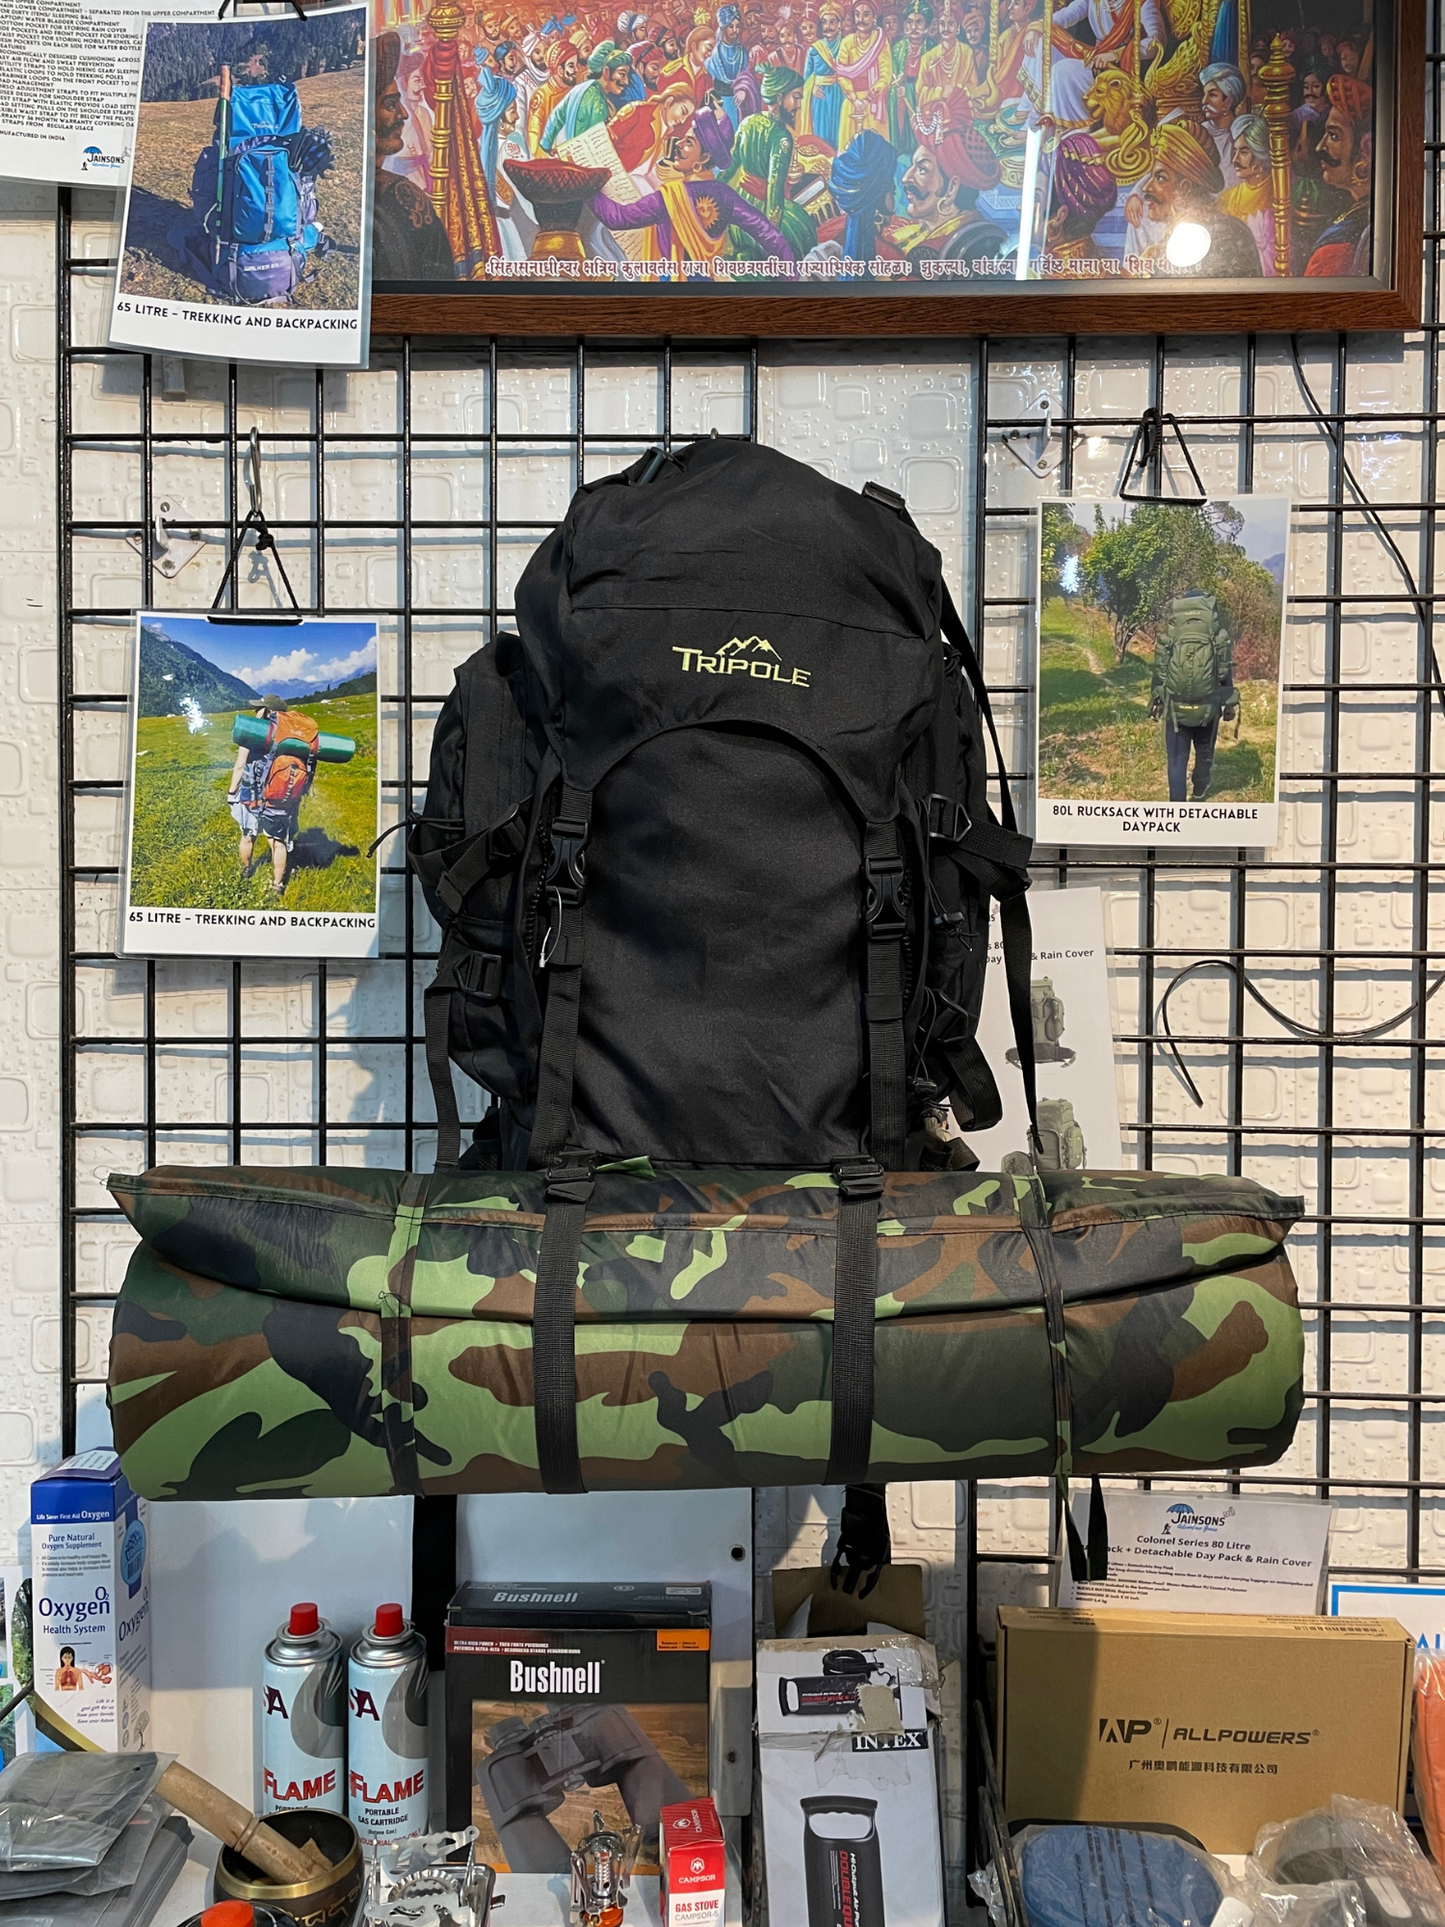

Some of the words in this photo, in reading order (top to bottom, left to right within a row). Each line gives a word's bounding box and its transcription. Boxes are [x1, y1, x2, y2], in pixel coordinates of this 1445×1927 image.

[87, 154, 124, 164] JAINSONS
[682, 258, 708, 276] राजा
[1069, 258, 1100, 274] माना
[1102, 258, 1120, 274] या
[117, 302, 131, 312] 65
[135, 304, 169, 317] LITRE
[182, 310, 241, 325] TREKKING
[246, 317, 272, 327] AND
[276, 318, 357, 329] BACKPACKING
[672, 646, 811, 687] TRIPOLE
[1053, 806, 1073, 816] 80L
[1077, 806, 1139, 818] RUCKSACK
[1144, 808, 1174, 818] WITH
[1179, 808, 1258, 819] DETACHABLE
[1123, 821, 1180, 832] DAYPACK
[129, 912, 143, 922] 65
[148, 913, 181, 923] LITRE
[196, 914, 255, 926] TREKKING
[260, 916, 286, 926] AND
[291, 917, 375, 928] BACKPACKING
[1041, 951, 1062, 960] Rain
[1065, 950, 1094, 958] Cover
[81, 1510, 110, 1520] Oxygen
[1171, 1512, 1225, 1526] JAINSONS
[67, 1533, 95, 1541] Natural
[1137, 1535, 1176, 1545] Colonel
[1178, 1538, 1208, 1547] Series
[1212, 1540, 1224, 1549] 80
[1227, 1541, 1251, 1551] Litre
[42, 1542, 64, 1551] Oxygen
[66, 1542, 102, 1550] Supplement
[1134, 1547, 1192, 1559] Detachable
[1196, 1551, 1216, 1562] Day
[1218, 1553, 1242, 1562] Pack
[1256, 1556, 1279, 1565] Rain
[1282, 1558, 1312, 1567] Cover
[493, 1592, 578, 1603] Bushnell
[39, 1598, 110, 1622] Oxygen
[119, 1600, 149, 1641] Oxygen
[43, 1625, 71, 1634] Health
[74, 1625, 105, 1636] System
[510, 1660, 600, 1694] Bushnell
[1128, 1759, 1278, 1775] 广州奥鹏能源科技有限公司
[264, 1767, 336, 1801] FLAME
[350, 1770, 424, 1804] FLAME
[365, 1807, 399, 1816] PORTABLE
[358, 1816, 369, 1825] GAS
[371, 1814, 408, 1826] CARTRIDGE
[691, 1809, 702, 1832] CAMPSOR
[679, 1874, 716, 1883] CAMPSOR
[839, 1850, 851, 1904] DOUBLE
[676, 1903, 692, 1913] GAS
[695, 1900, 719, 1911] STOVE
[675, 1910, 718, 1921] CAMPSOR-5
